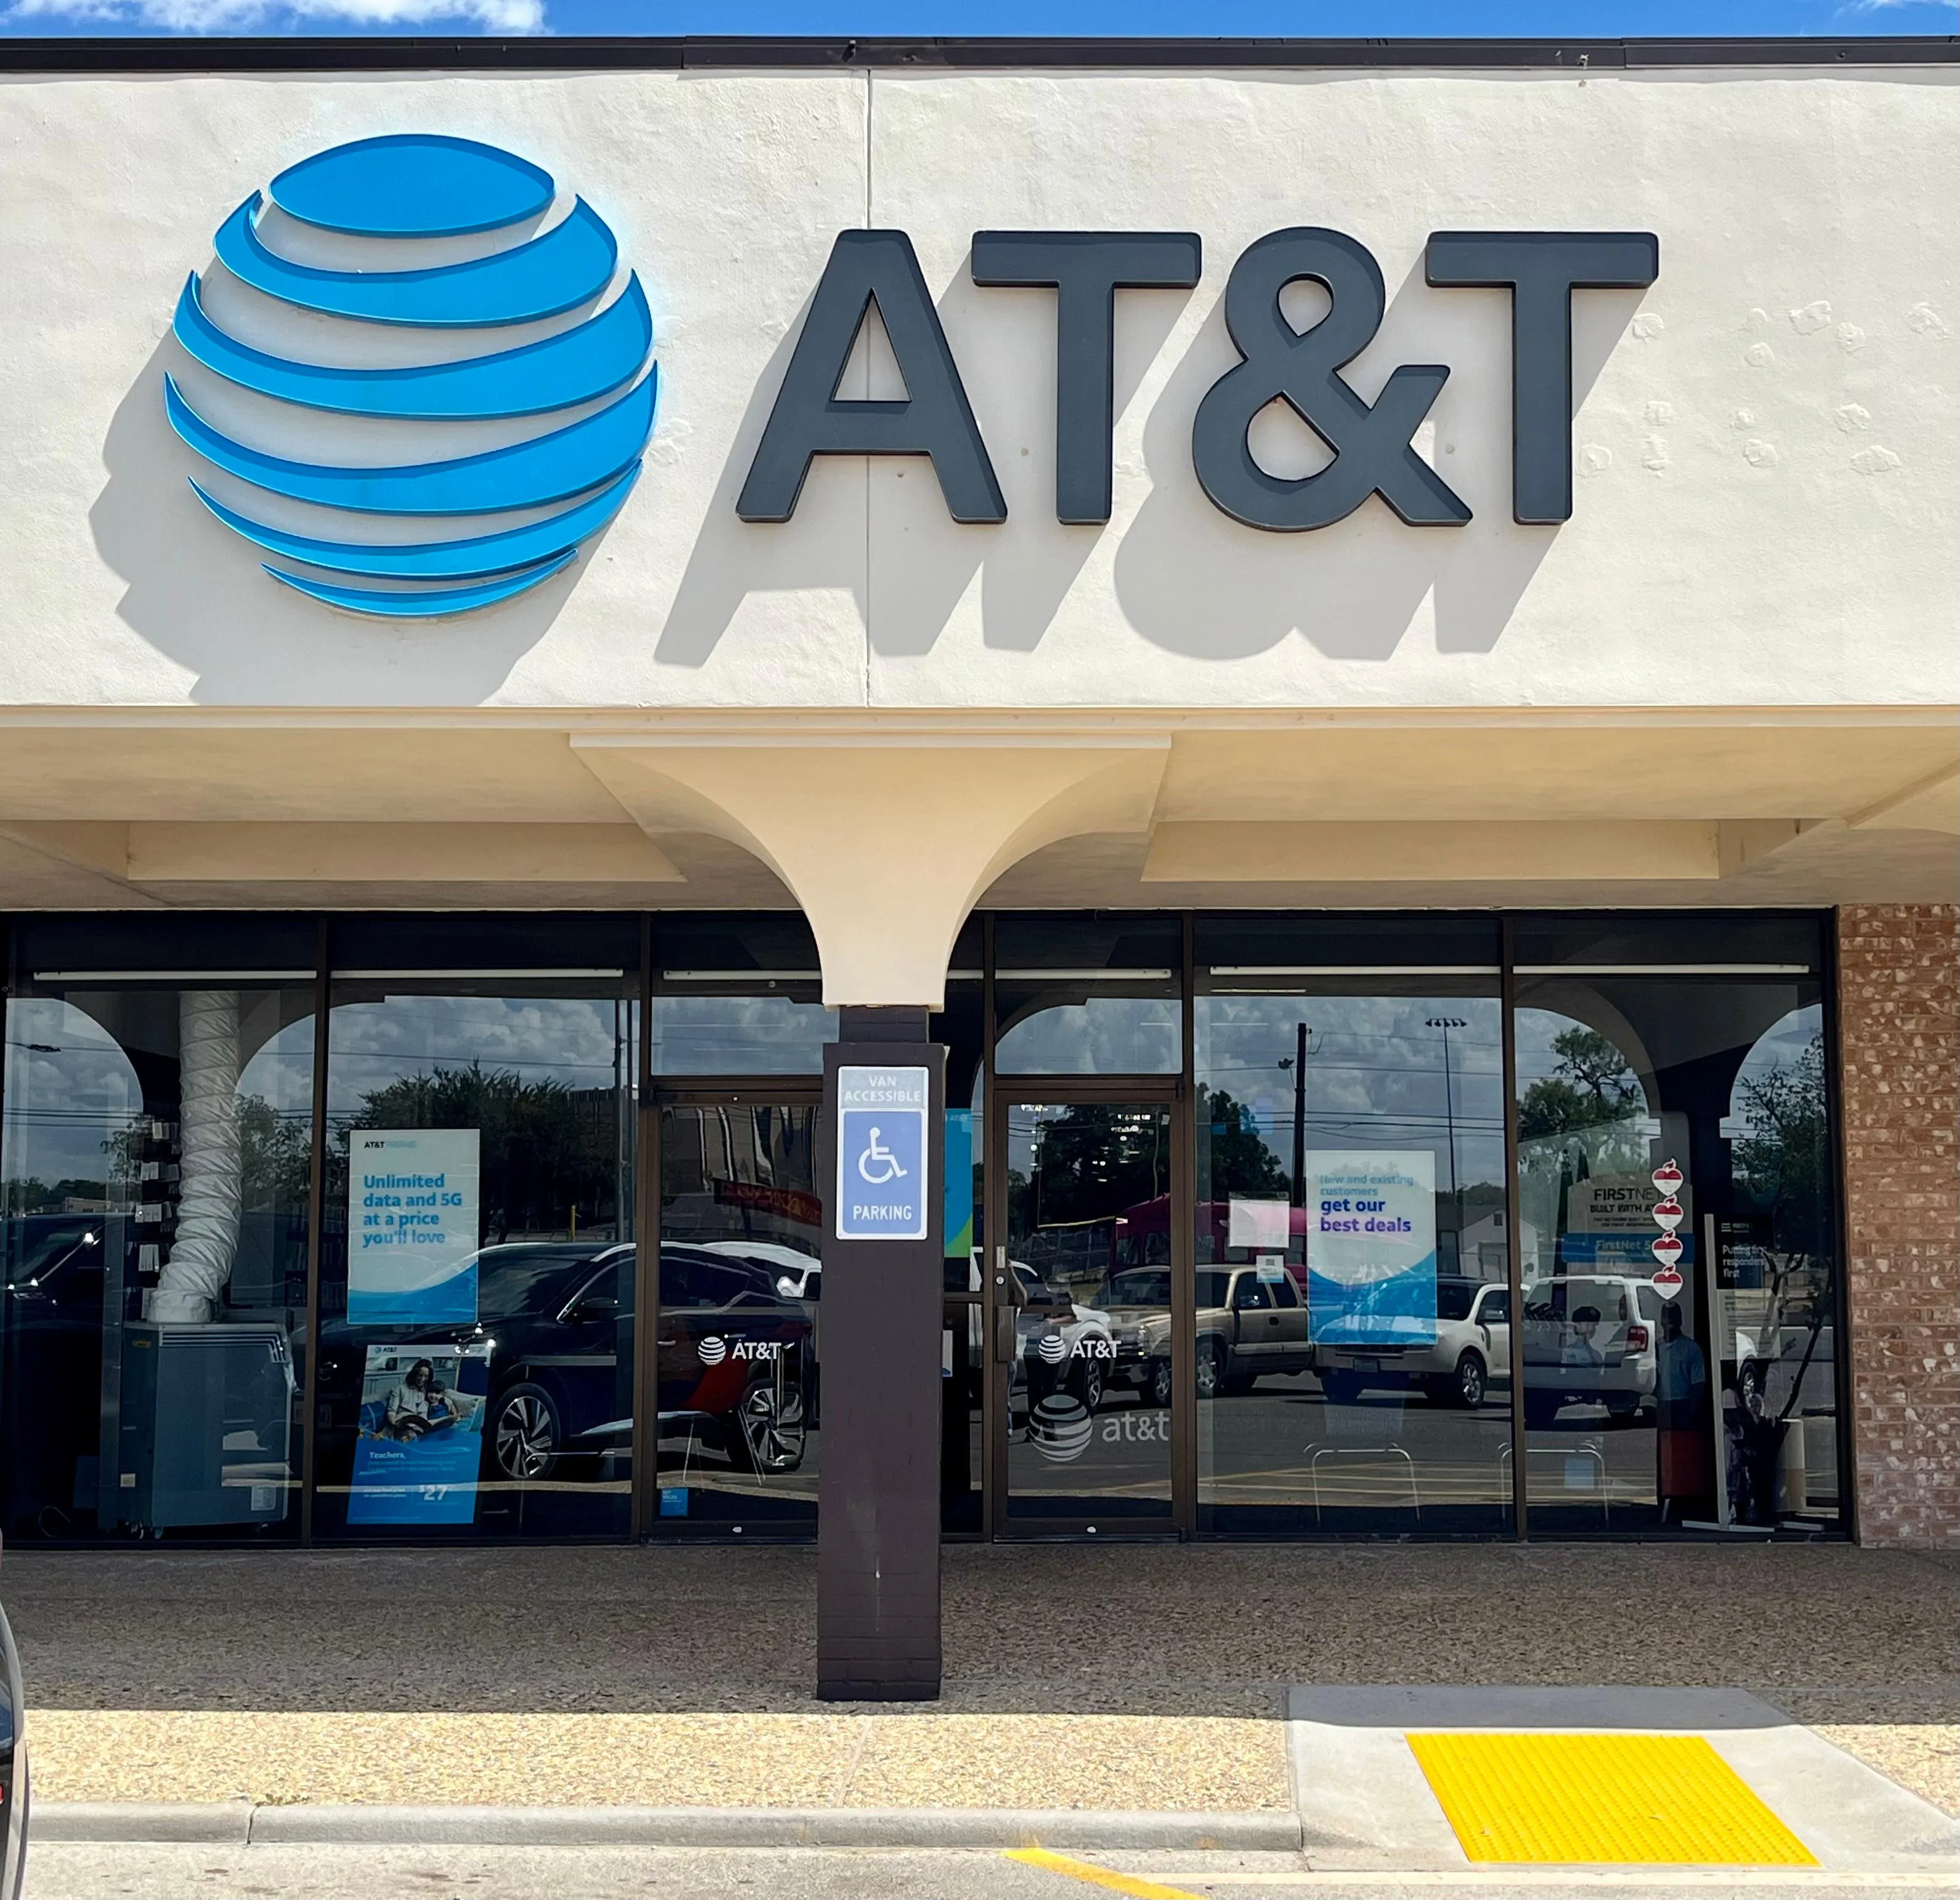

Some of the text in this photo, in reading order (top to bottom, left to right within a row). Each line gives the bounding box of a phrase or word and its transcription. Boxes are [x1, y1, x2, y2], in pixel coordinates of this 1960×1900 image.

[735, 226, 1660, 533] AT&T
[868, 1076, 897, 1087] VAN
[844, 1090, 921, 1102] ACCESSIBLE
[363, 1173, 446, 1189] Unlimited
[1347, 1175, 1367, 1184] and
[1370, 1174, 1414, 1187] existing
[1320, 1187, 1379, 1196] customers
[363, 1192, 463, 1207] data and 5G
[853, 1205, 912, 1221] PARKING
[1321, 1199, 1386, 1216] get our
[1590, 1205, 1614, 1213] BUILT
[1618, 1204, 1642, 1213] WITH
[363, 1211, 440, 1229] at a price
[1320, 1217, 1411, 1232] best deals
[363, 1229, 446, 1248] you'll love
[1596, 1239, 1641, 1251] FirstNet
[731, 1342, 782, 1359] AT&T
[1070, 1340, 1122, 1358] AT&T
[1102, 1412, 1170, 1442] at&t
[369, 1451, 406, 1459] Teachers,
